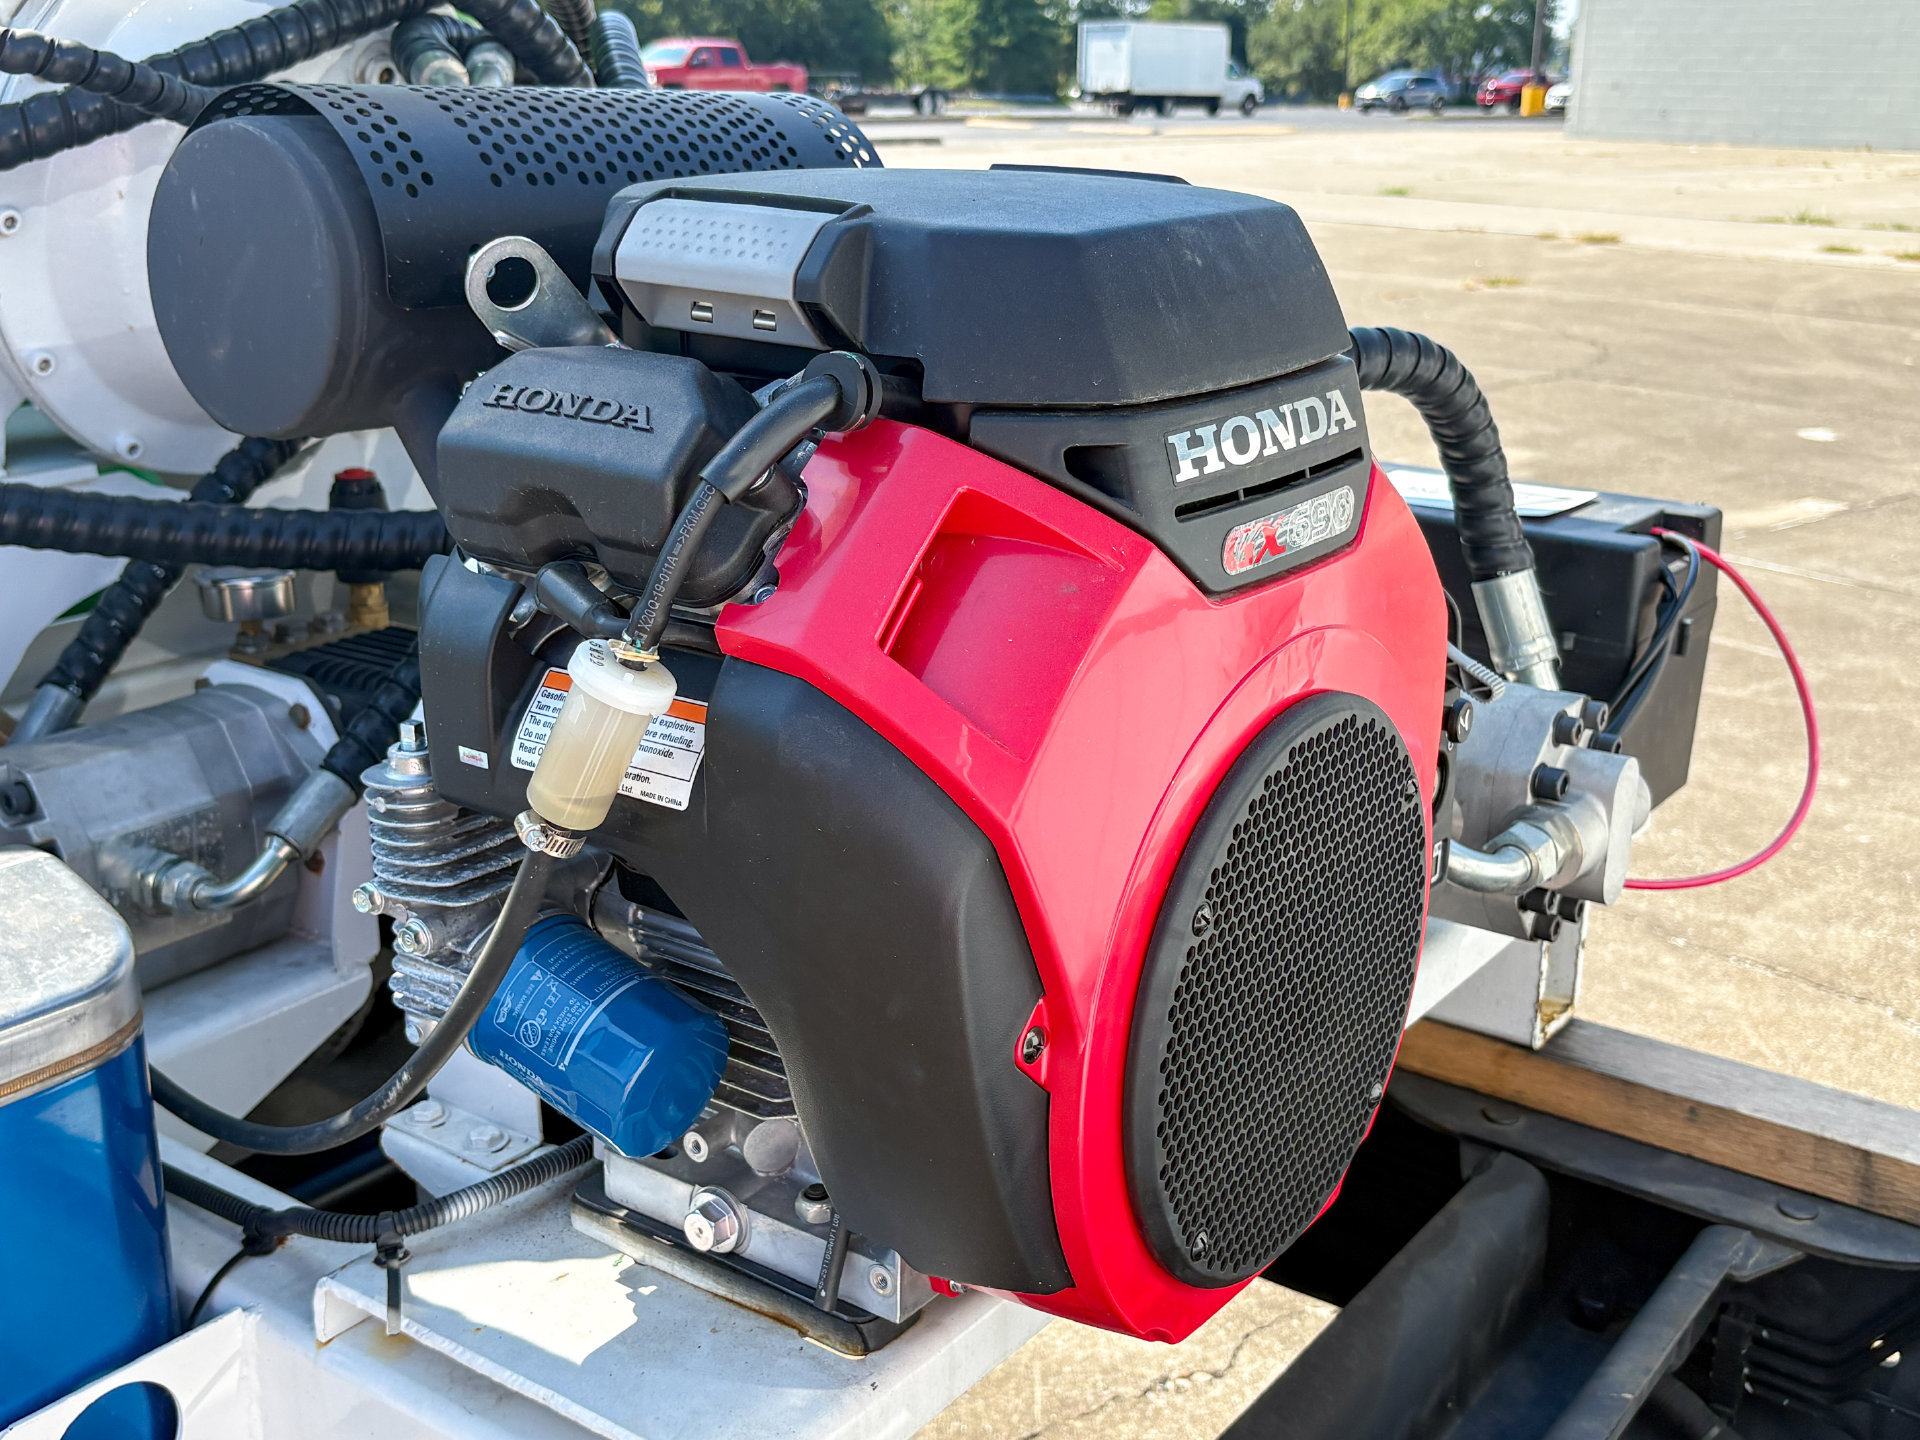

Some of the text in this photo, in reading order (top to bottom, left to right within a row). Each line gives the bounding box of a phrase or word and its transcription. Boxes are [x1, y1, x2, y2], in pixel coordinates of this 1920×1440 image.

[483, 384, 654, 433] HONDA
[1167, 389, 1357, 483] HONDA
[528, 715, 542, 726] The
[535, 701, 551, 712] Turn
[644, 729, 658, 738] ore
[659, 732, 694, 748] refueling.
[541, 689, 567, 702] Gasolin
[659, 718, 696, 734] explosive.
[523, 727, 547, 741] Do not
[518, 742, 537, 755] Read
[624, 771, 651, 785] eration.
[640, 790, 656, 800] MADE
[657, 794, 665, 802] IN
[664, 796, 682, 807] CHINA
[499, 1048, 545, 1087] HONDA
